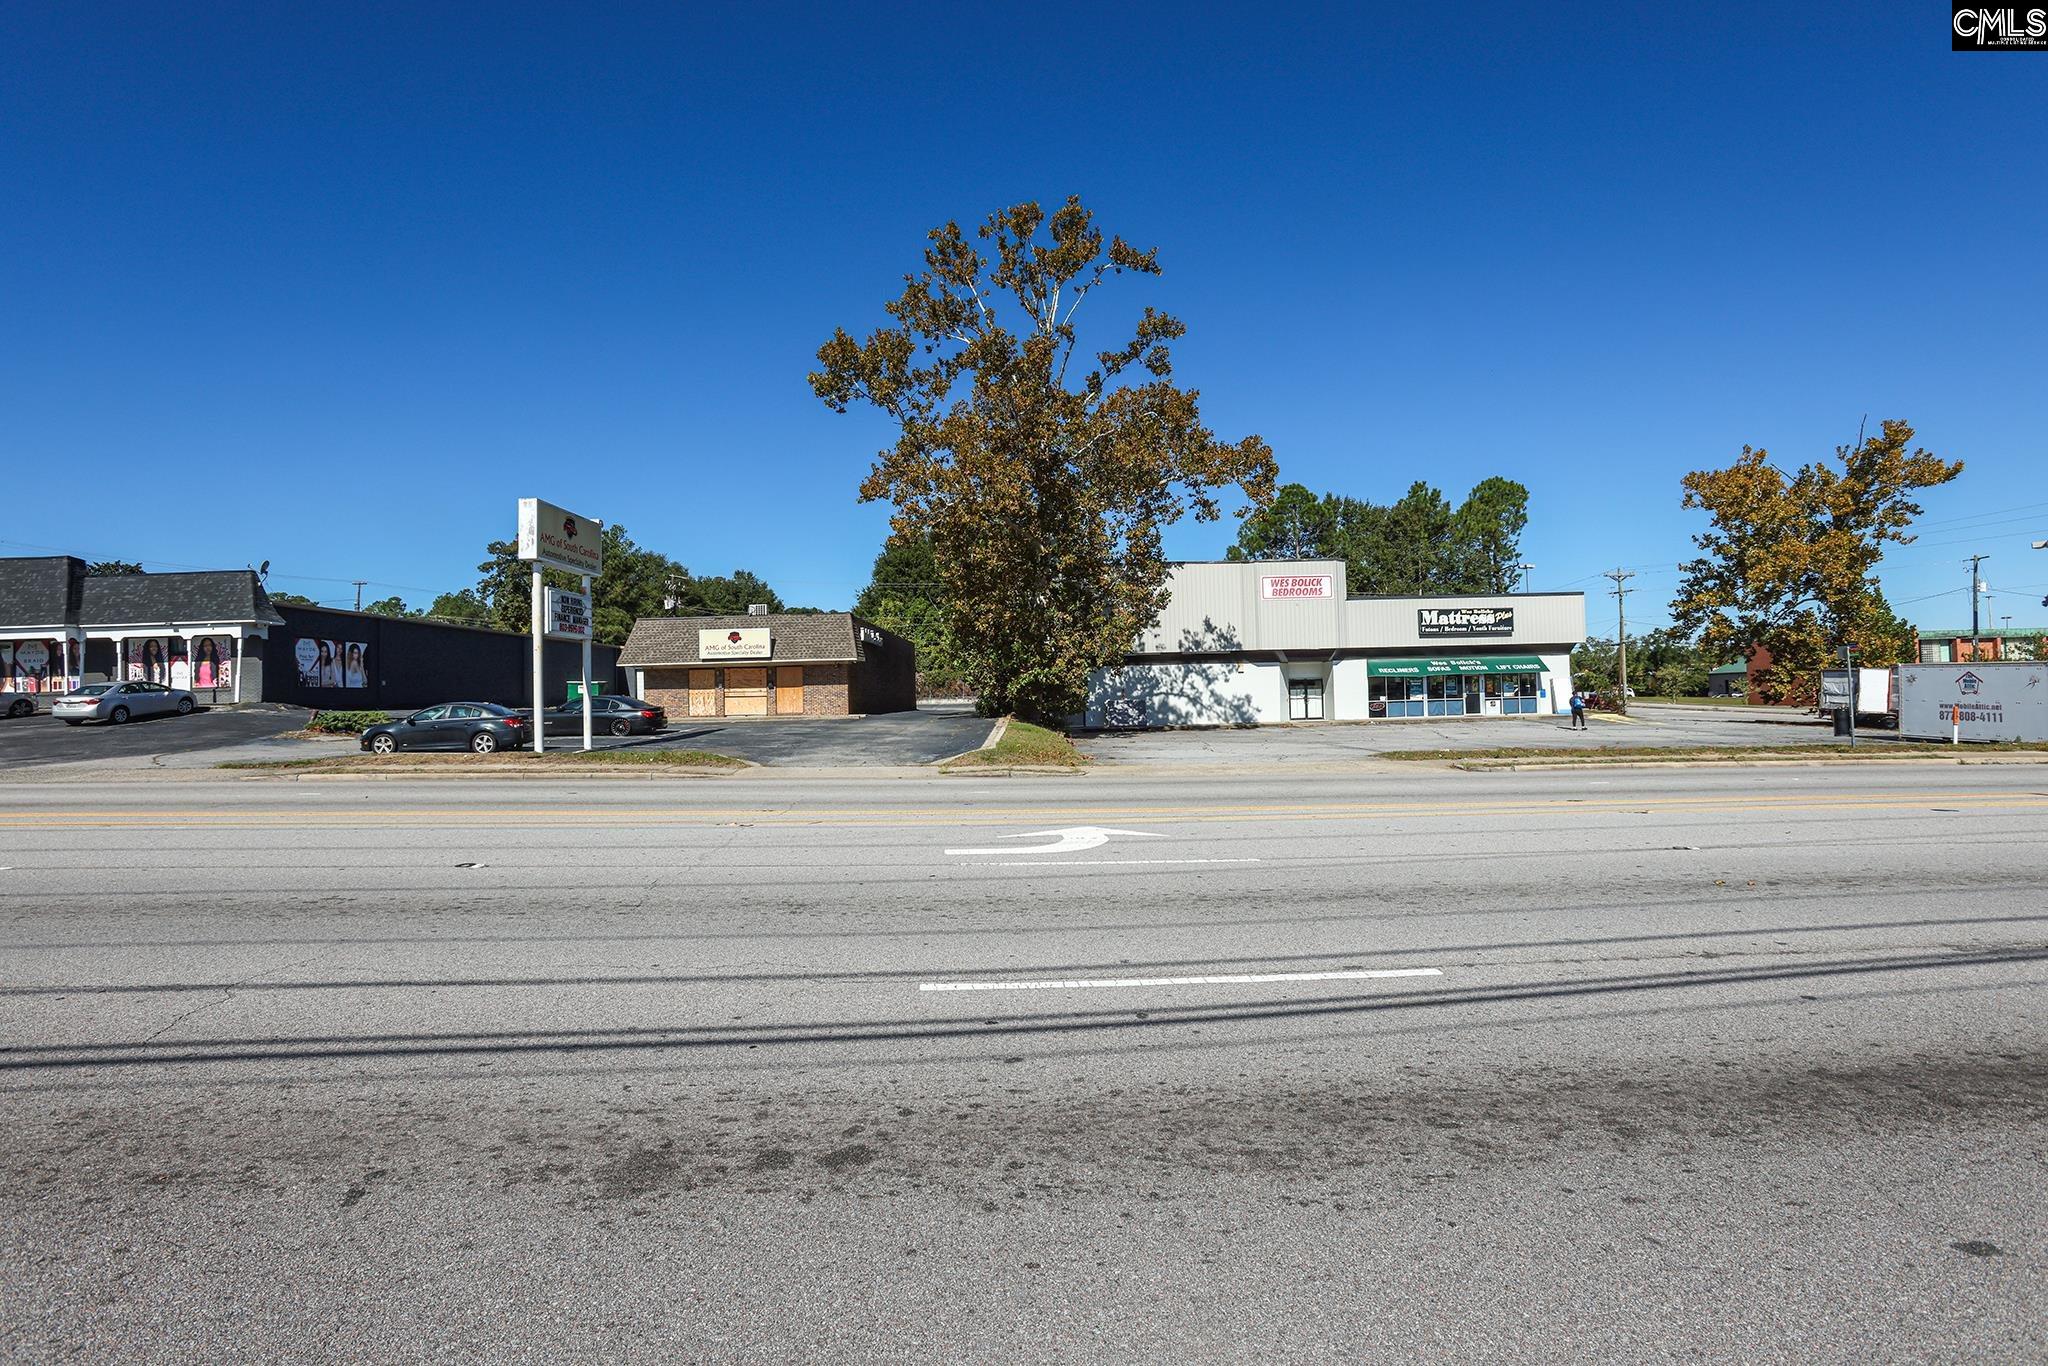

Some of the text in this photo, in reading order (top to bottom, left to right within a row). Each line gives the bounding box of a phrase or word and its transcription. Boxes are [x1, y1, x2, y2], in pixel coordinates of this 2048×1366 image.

[540, 532, 599, 560] AMG of South Carolina
[1270, 578, 1322, 588] WES BOLICK
[1272, 587, 1323, 596] BEDROOMS
[1420, 610, 1512, 626] Mattress Plus
[1939, 711, 2003, 723] 877808-4111
